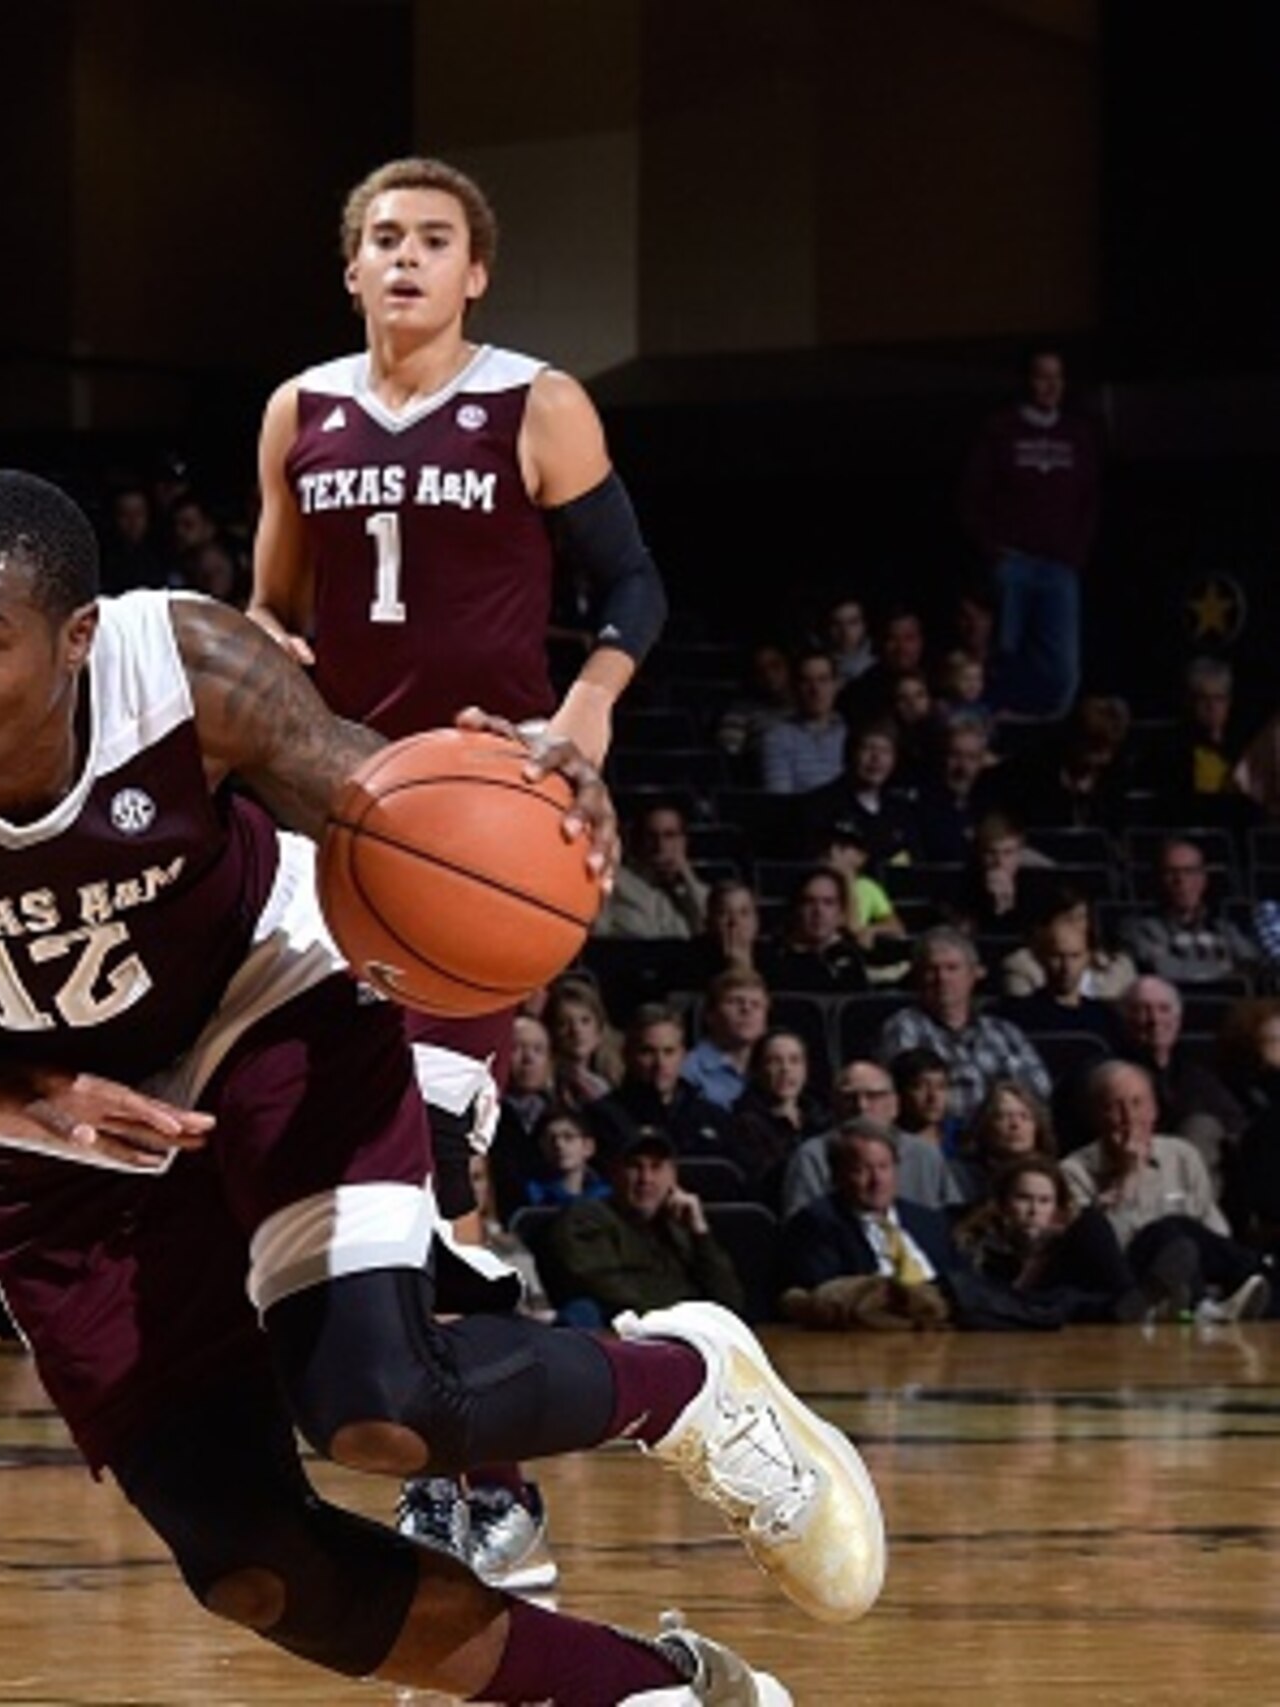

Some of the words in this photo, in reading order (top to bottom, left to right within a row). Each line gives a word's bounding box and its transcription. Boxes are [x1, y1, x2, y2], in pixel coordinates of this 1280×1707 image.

[298, 464, 406, 514] TEXAS
[414, 465, 497, 513] A&M
[366, 511, 406, 622] 1
[77, 856, 186, 923] A&M
